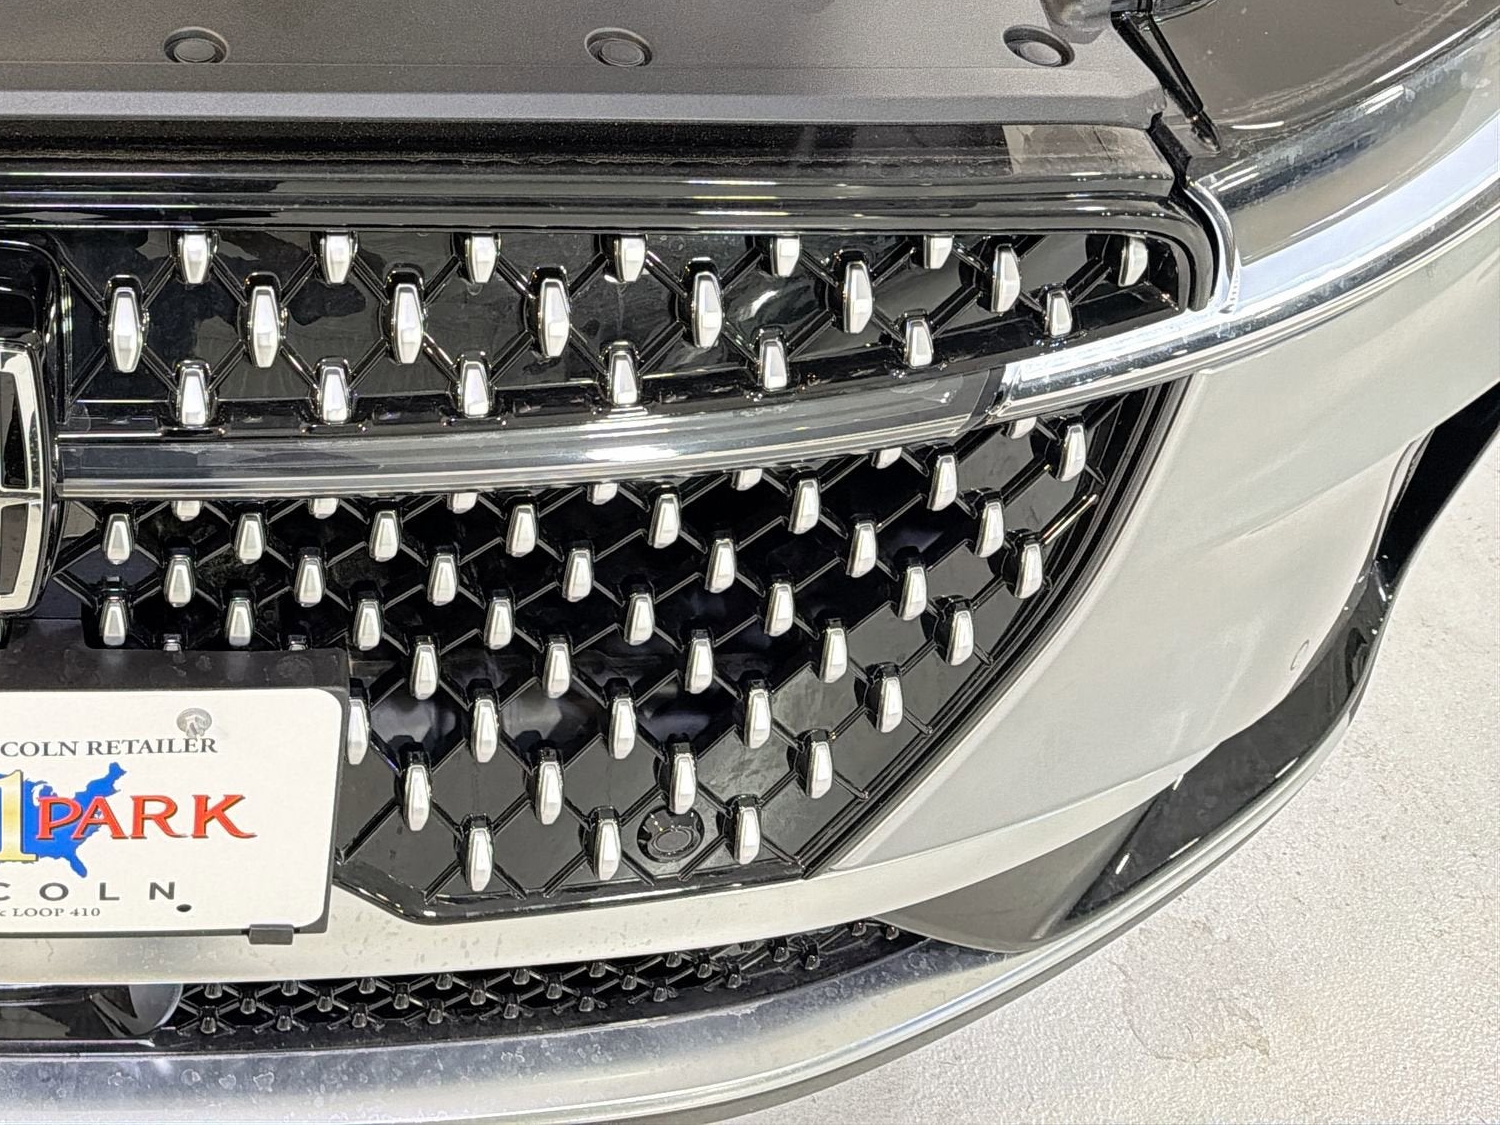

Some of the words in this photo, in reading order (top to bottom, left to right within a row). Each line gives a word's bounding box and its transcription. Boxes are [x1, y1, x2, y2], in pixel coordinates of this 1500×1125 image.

[86, 737, 219, 756] RETAILER
[35, 793, 258, 840] PARK
[12, 907, 65, 917] LOOP
[68, 907, 101, 917] 410
